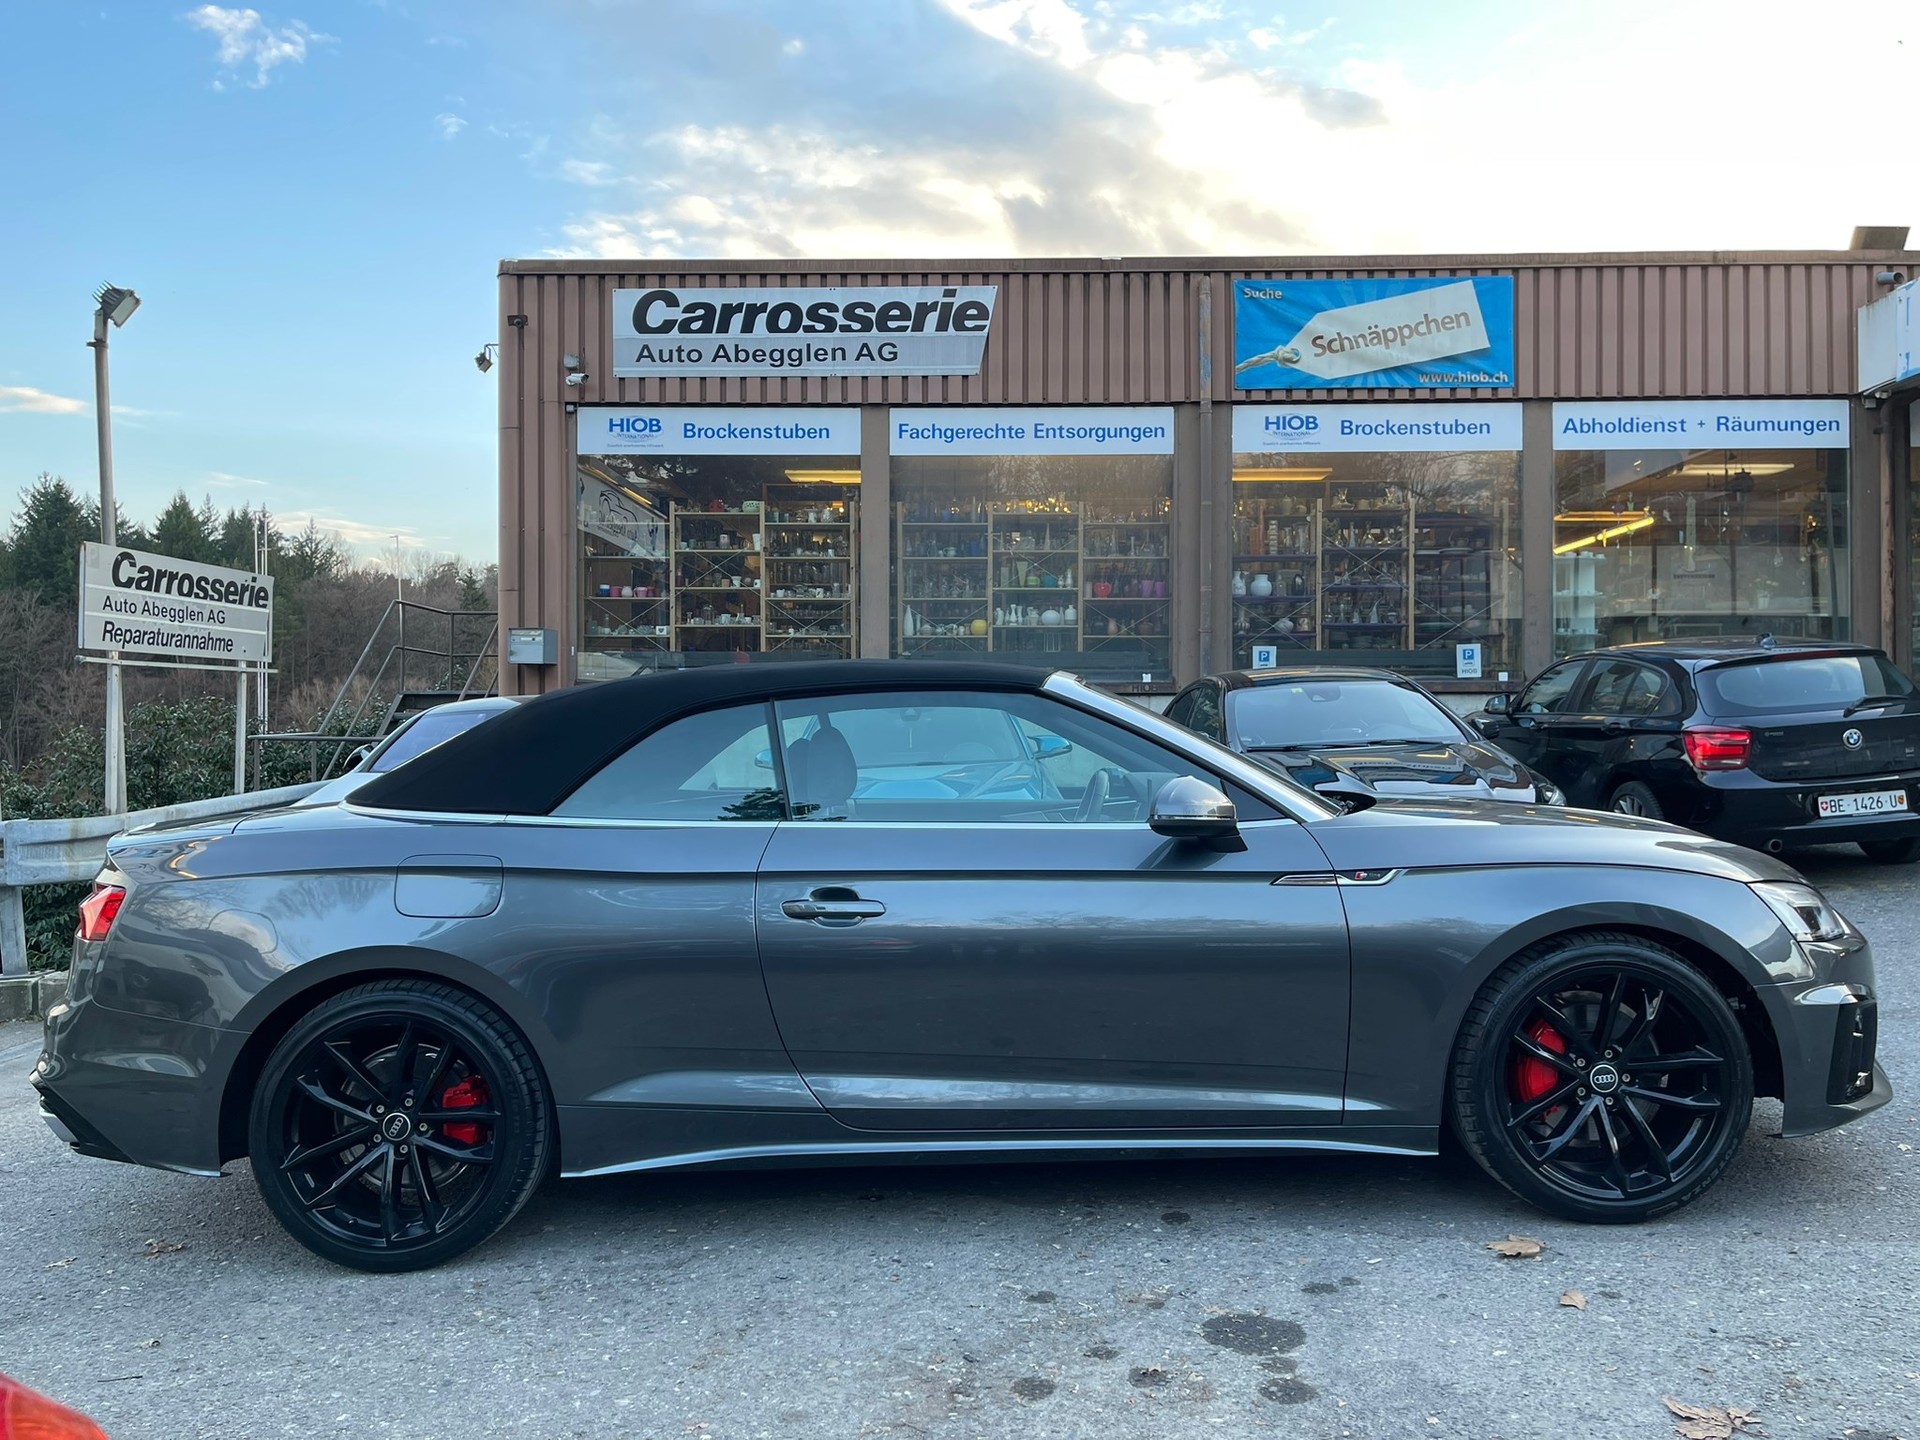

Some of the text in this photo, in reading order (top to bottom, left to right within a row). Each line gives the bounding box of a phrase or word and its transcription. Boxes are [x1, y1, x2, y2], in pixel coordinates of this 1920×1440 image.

[1243, 287, 1283, 300] Suche
[632, 288, 990, 334] Carrosserie
[1311, 310, 1471, 358] Schnäppchen
[635, 342, 899, 368] Auto Abegglen AG
[1418, 371, 1509, 384] www.hiob.ch
[608, 418, 662, 433] HIOB
[684, 422, 830, 440] Brockenstuben
[898, 422, 1166, 444] Fachgerechte Entsorgungen
[1264, 416, 1319, 431] HIOB
[1341, 418, 1491, 436] Brockenstuben
[1562, 416, 1840, 436] Abholdienst + Räumungen
[112, 551, 269, 609] Carrosserie
[102, 595, 226, 624] Auto Abegglen AG
[102, 620, 234, 653] Reparaturannahme
[1260, 652, 1268, 661] P
[1464, 650, 1472, 659] P
[1830, 794, 1898, 813] BE 1426 U
